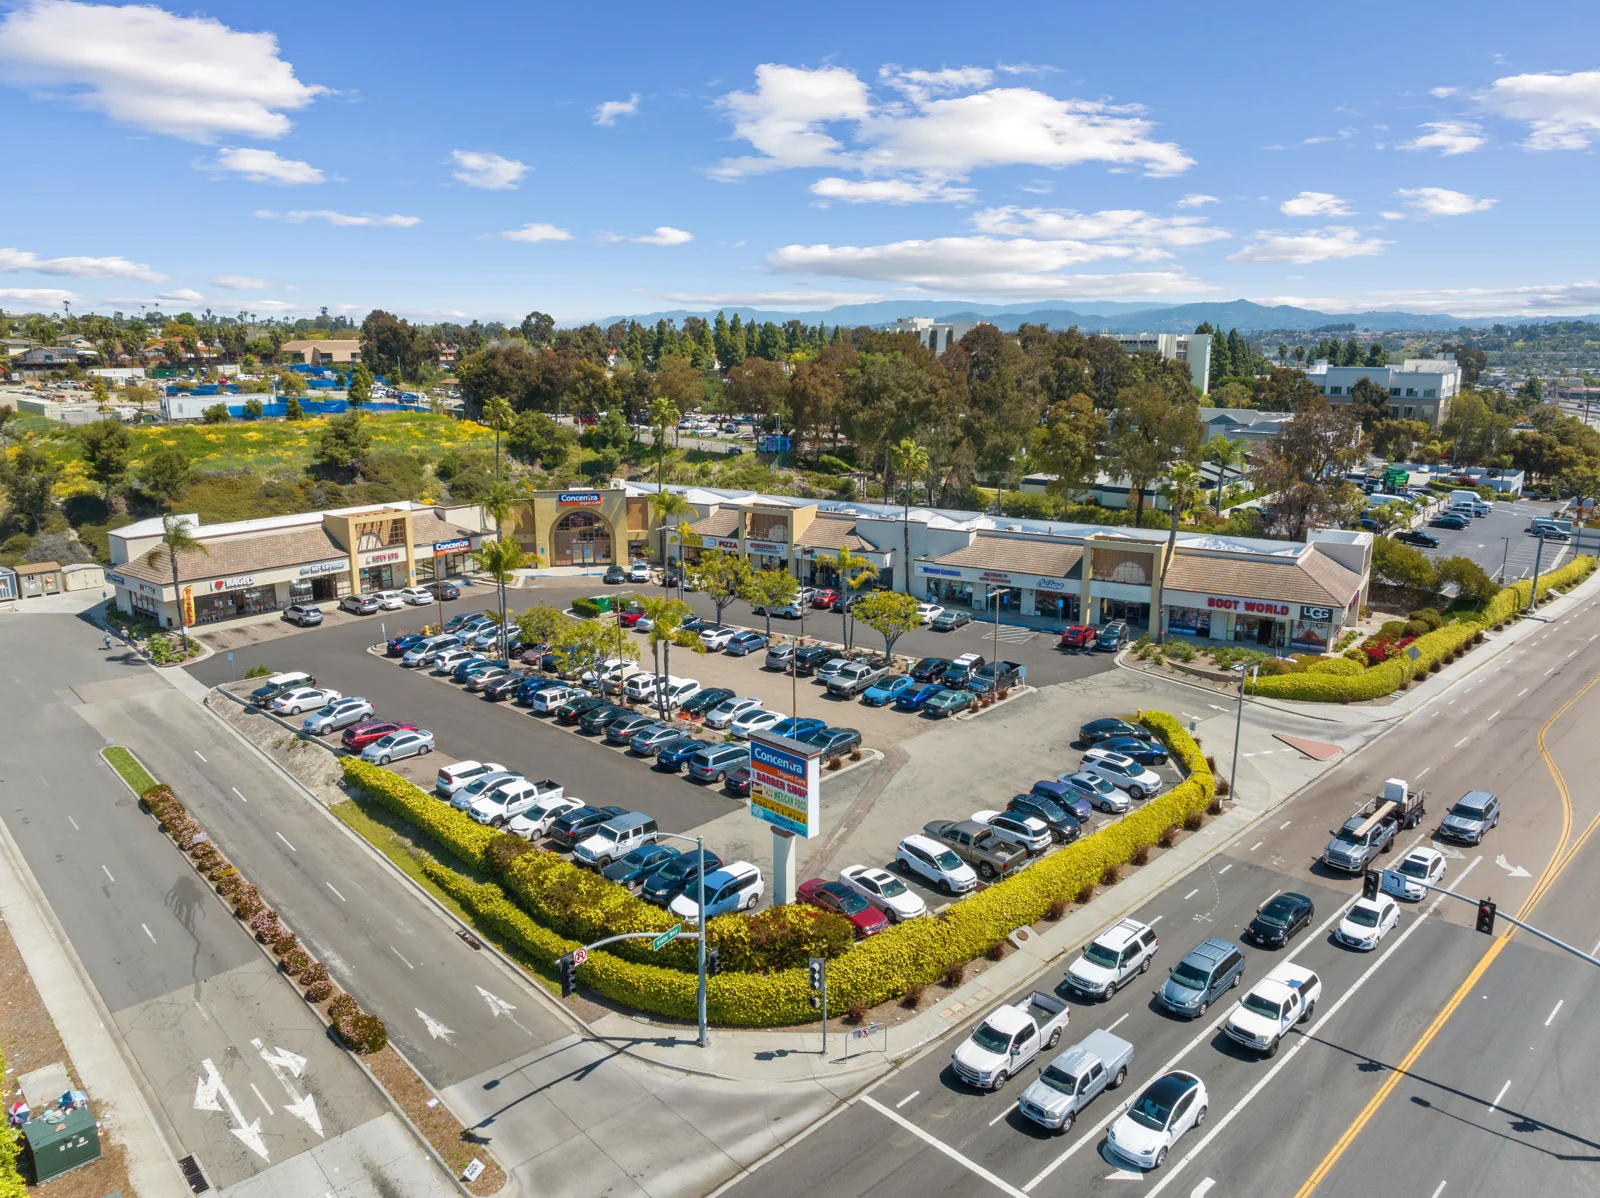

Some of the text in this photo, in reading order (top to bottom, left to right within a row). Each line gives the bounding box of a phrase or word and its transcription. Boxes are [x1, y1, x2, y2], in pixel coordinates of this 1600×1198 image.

[561, 494, 598, 502] Concentra
[436, 540, 470, 550] Concentra
[718, 540, 738, 548] PIZZA
[225, 576, 254, 589] BAGELS
[1208, 598, 1289, 616] BOOT WORLD
[1304, 606, 1328, 619] UGG
[754, 748, 802, 774] Concentra
[756, 771, 784, 790] BARBER
[786, 783, 806, 798] SHOP
[778, 769, 806, 786] Urgent Care
[773, 789, 793, 806] MEXICAN
[794, 797, 806, 810] FOOD
[752, 798, 806, 824] 800-411-PIKE
